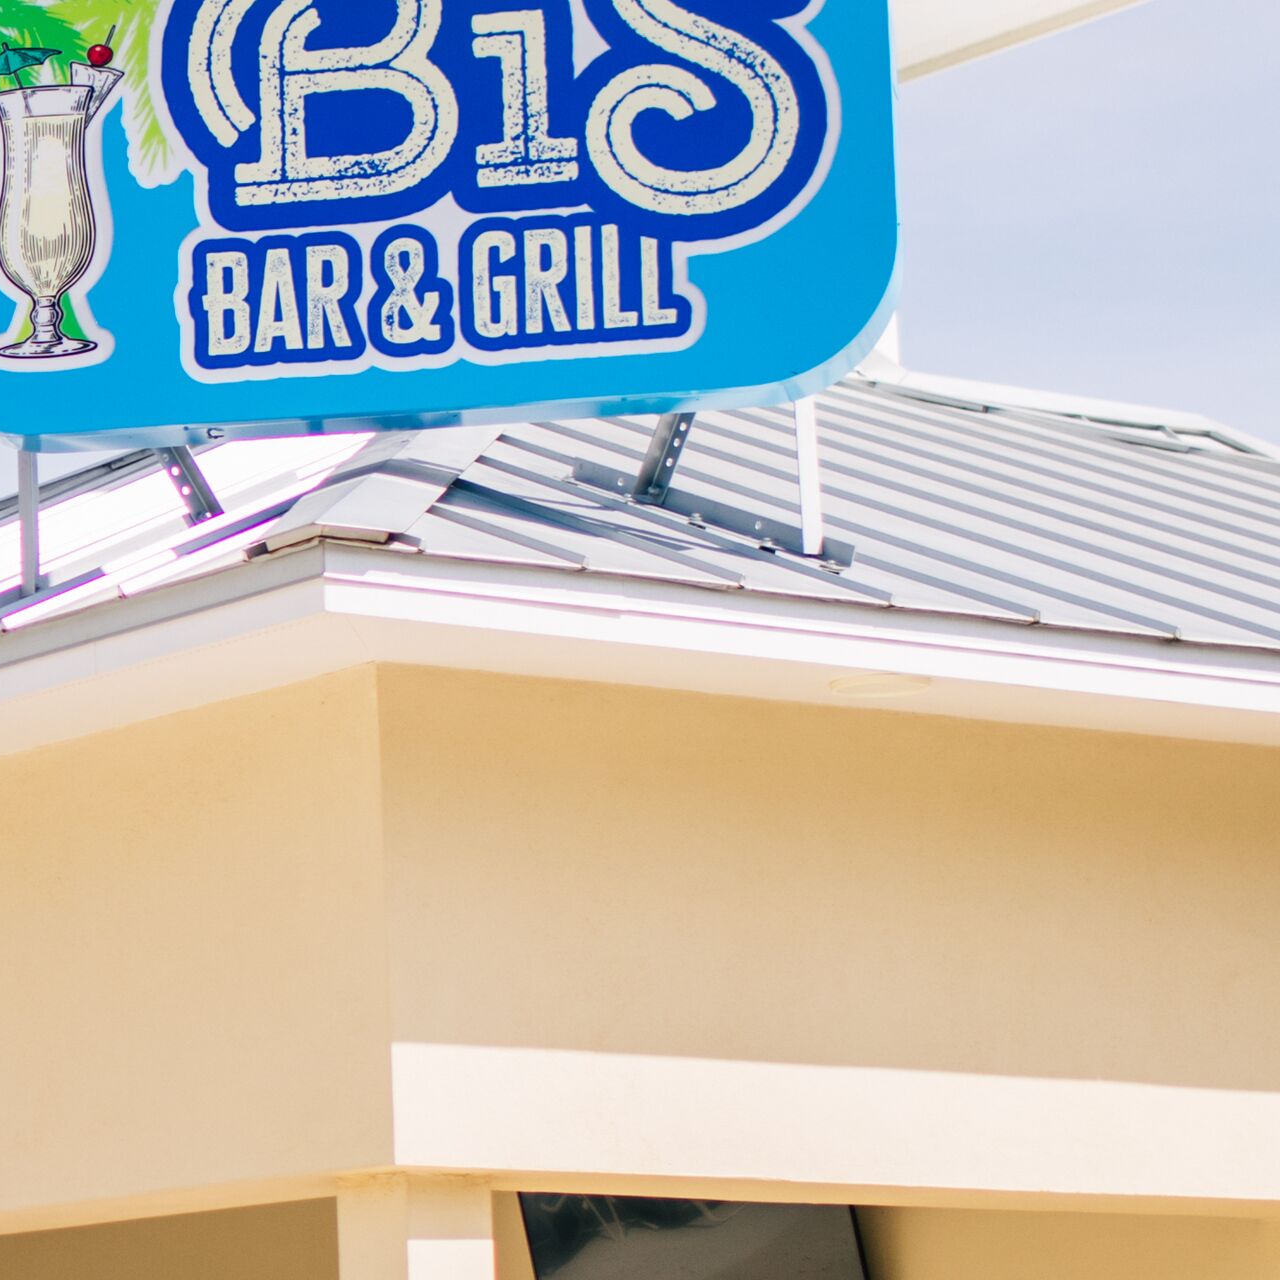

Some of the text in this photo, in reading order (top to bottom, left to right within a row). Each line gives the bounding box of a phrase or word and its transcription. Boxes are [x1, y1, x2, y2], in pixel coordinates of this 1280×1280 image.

[201, 223, 678, 356] BAR & GRILL
